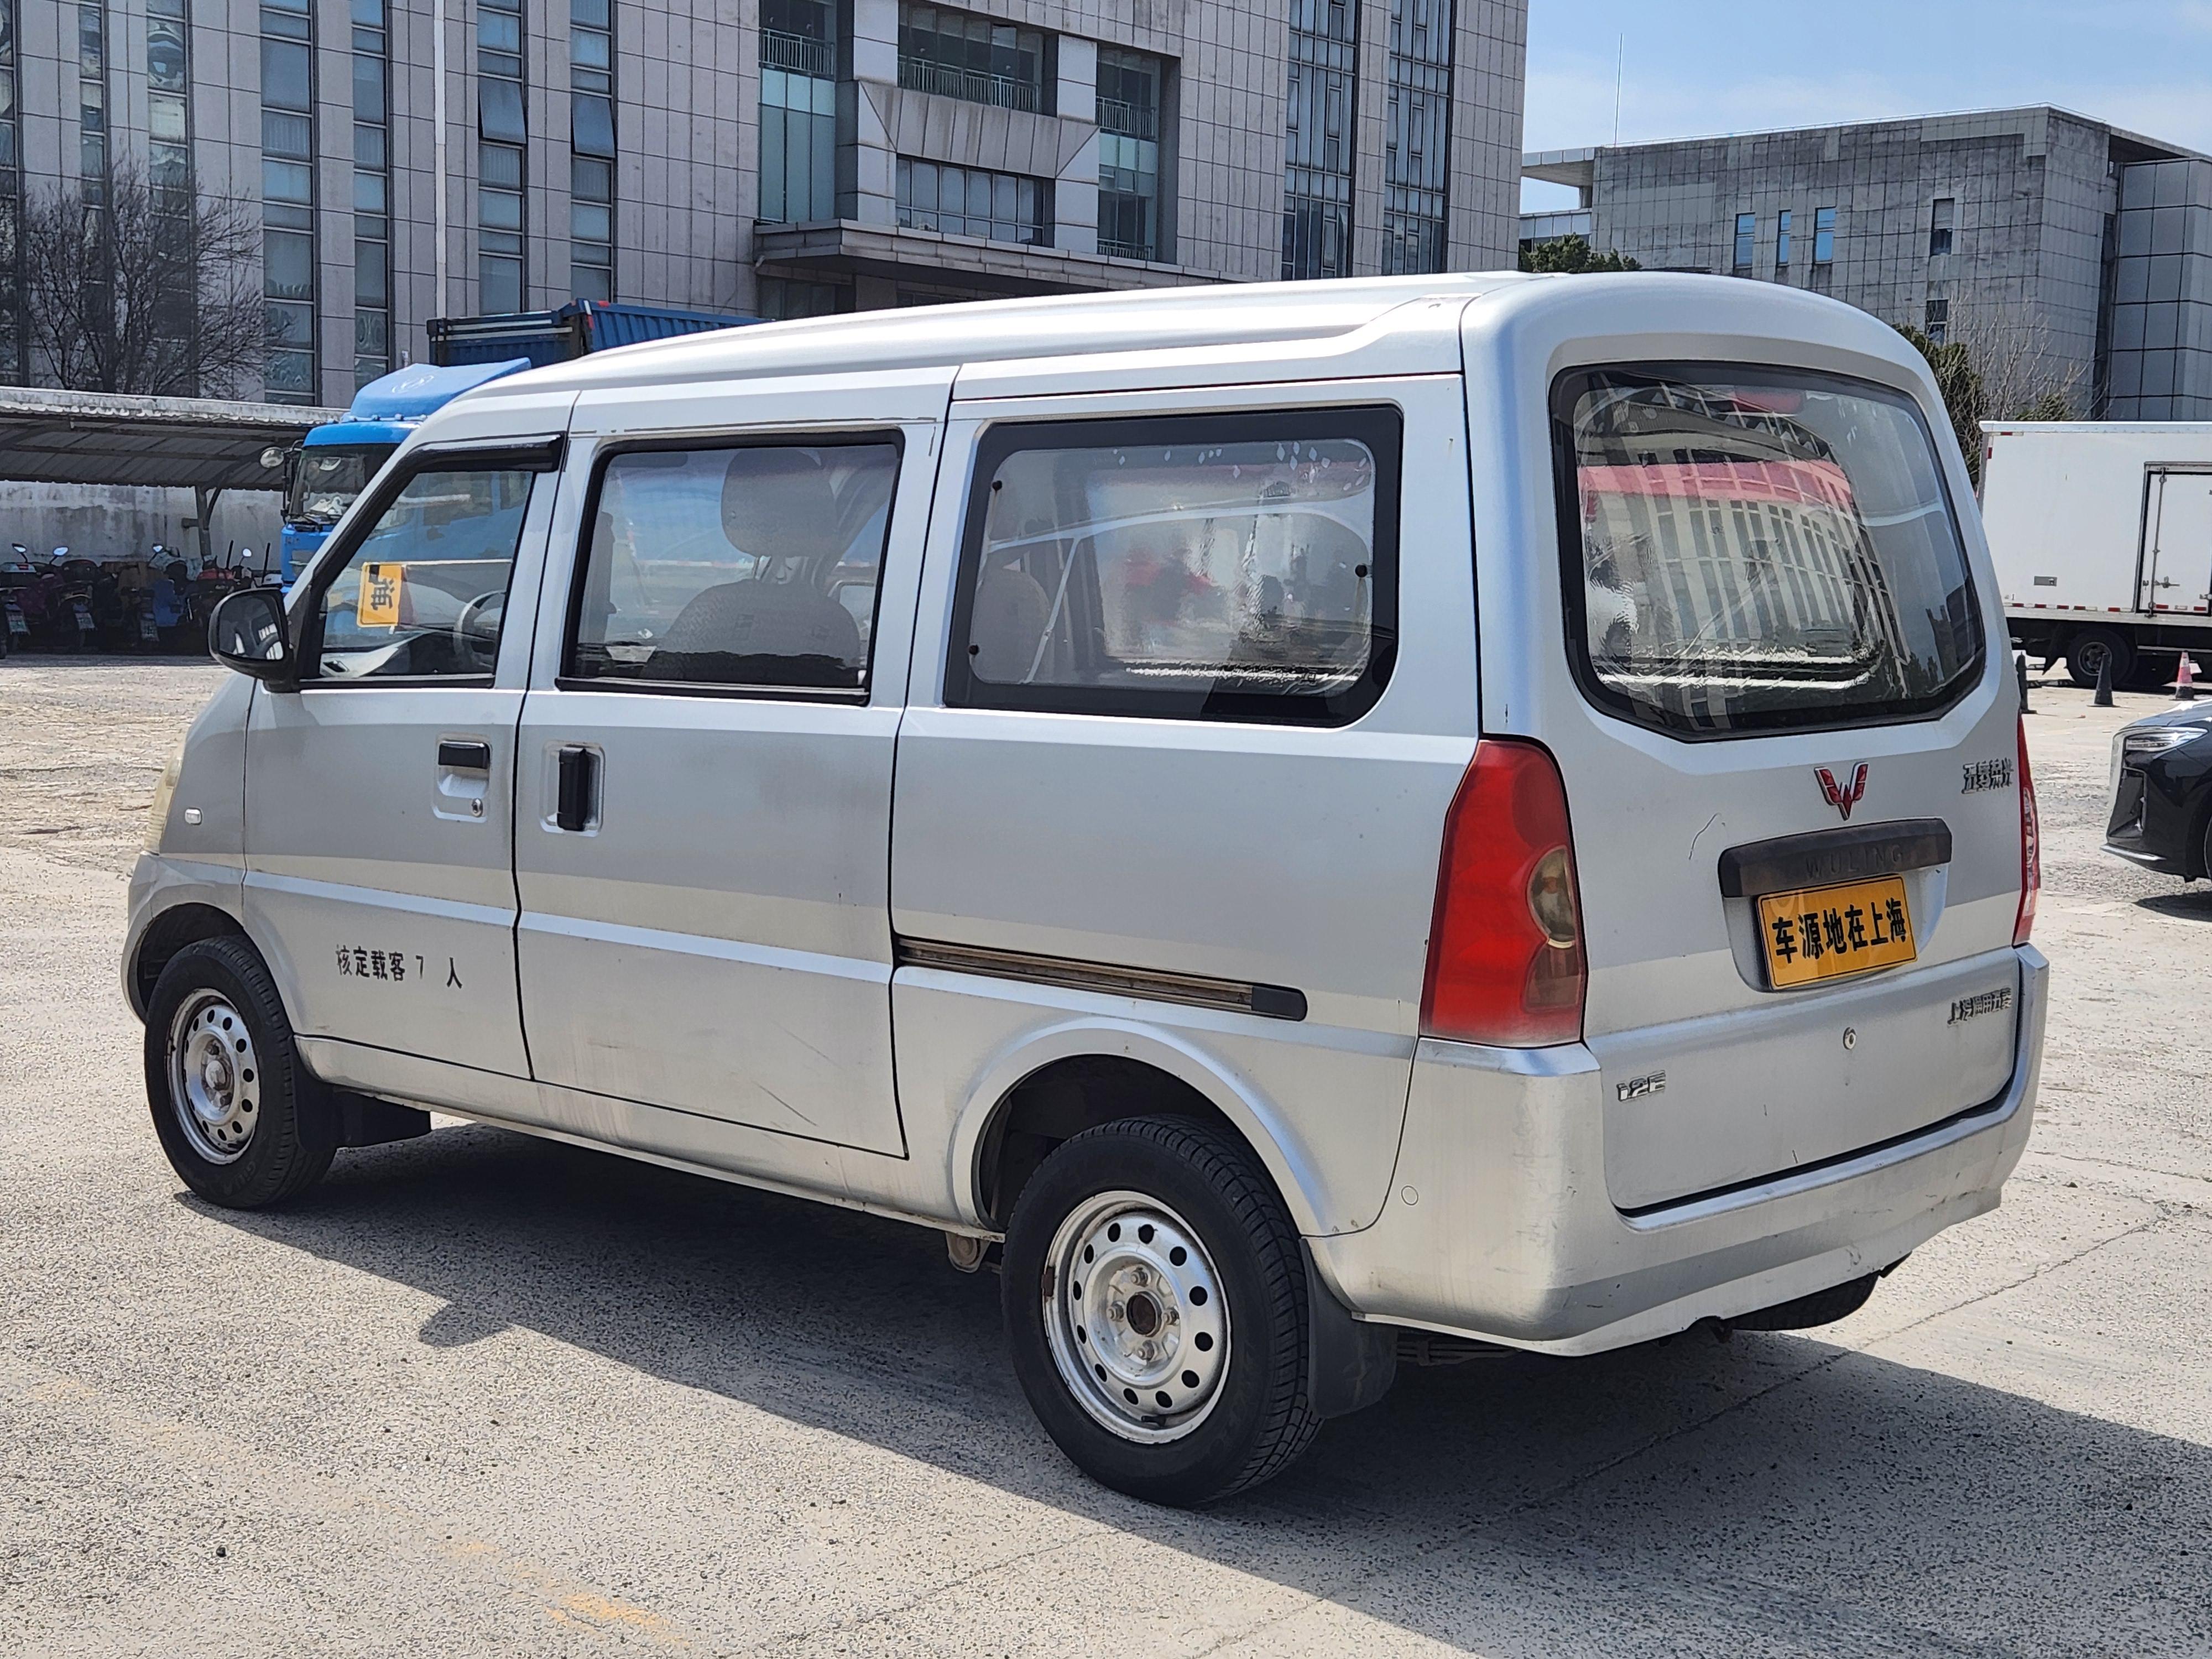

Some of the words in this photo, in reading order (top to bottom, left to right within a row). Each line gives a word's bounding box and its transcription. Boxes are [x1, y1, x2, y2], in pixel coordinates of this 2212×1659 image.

[1804, 843, 1903, 878] WULING
[1771, 897, 1907, 964] 车源地在上海
[335, 943, 405, 982] 核定载客
[446, 957, 463, 989] 人
